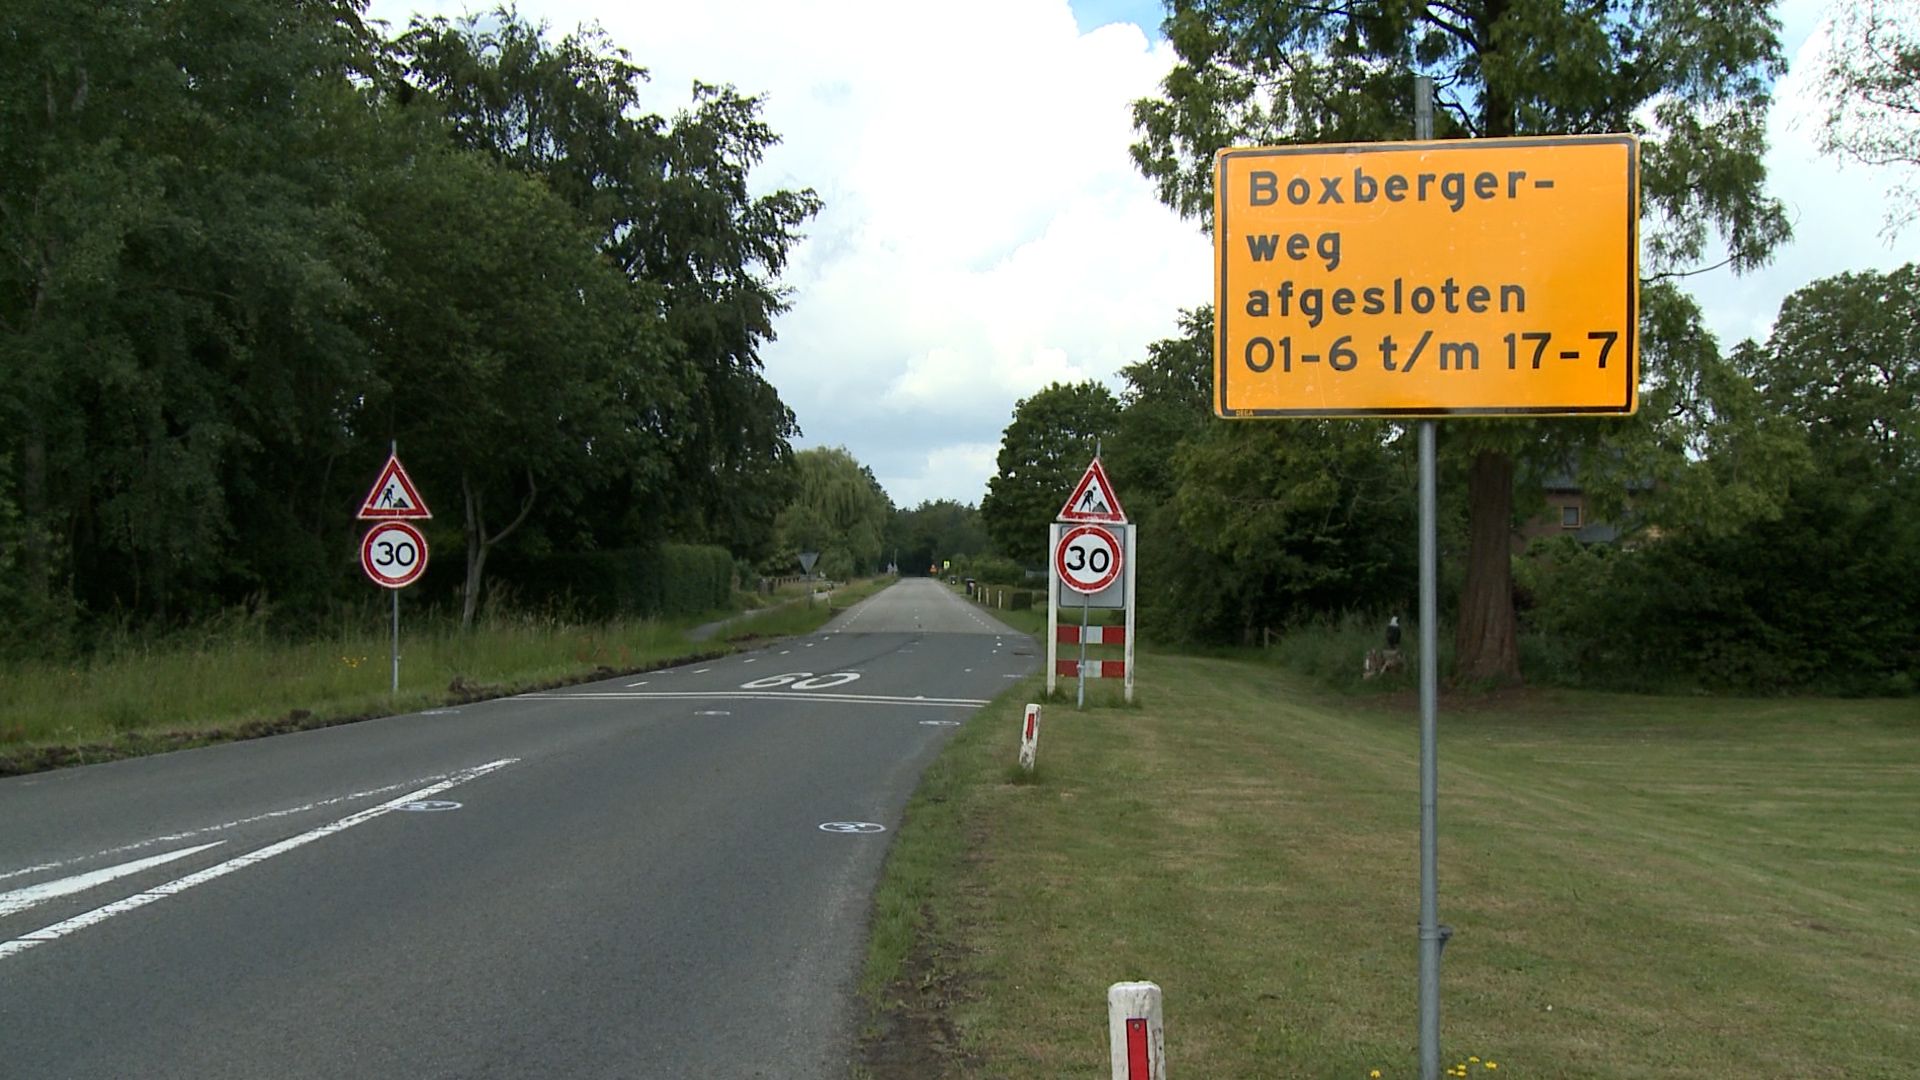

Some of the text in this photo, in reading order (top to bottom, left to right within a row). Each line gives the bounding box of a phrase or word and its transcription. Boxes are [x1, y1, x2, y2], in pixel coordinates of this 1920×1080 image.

[1249, 167, 1555, 212] Boxberger-
[1246, 232, 1341, 271] weg
[1245, 277, 1526, 328] afgesloten
[1244, 331, 1618, 373] 01-6 t/m 17-7
[375, 541, 416, 567] 30
[1066, 546, 1110, 573] 30
[740, 671, 861, 690] 60
